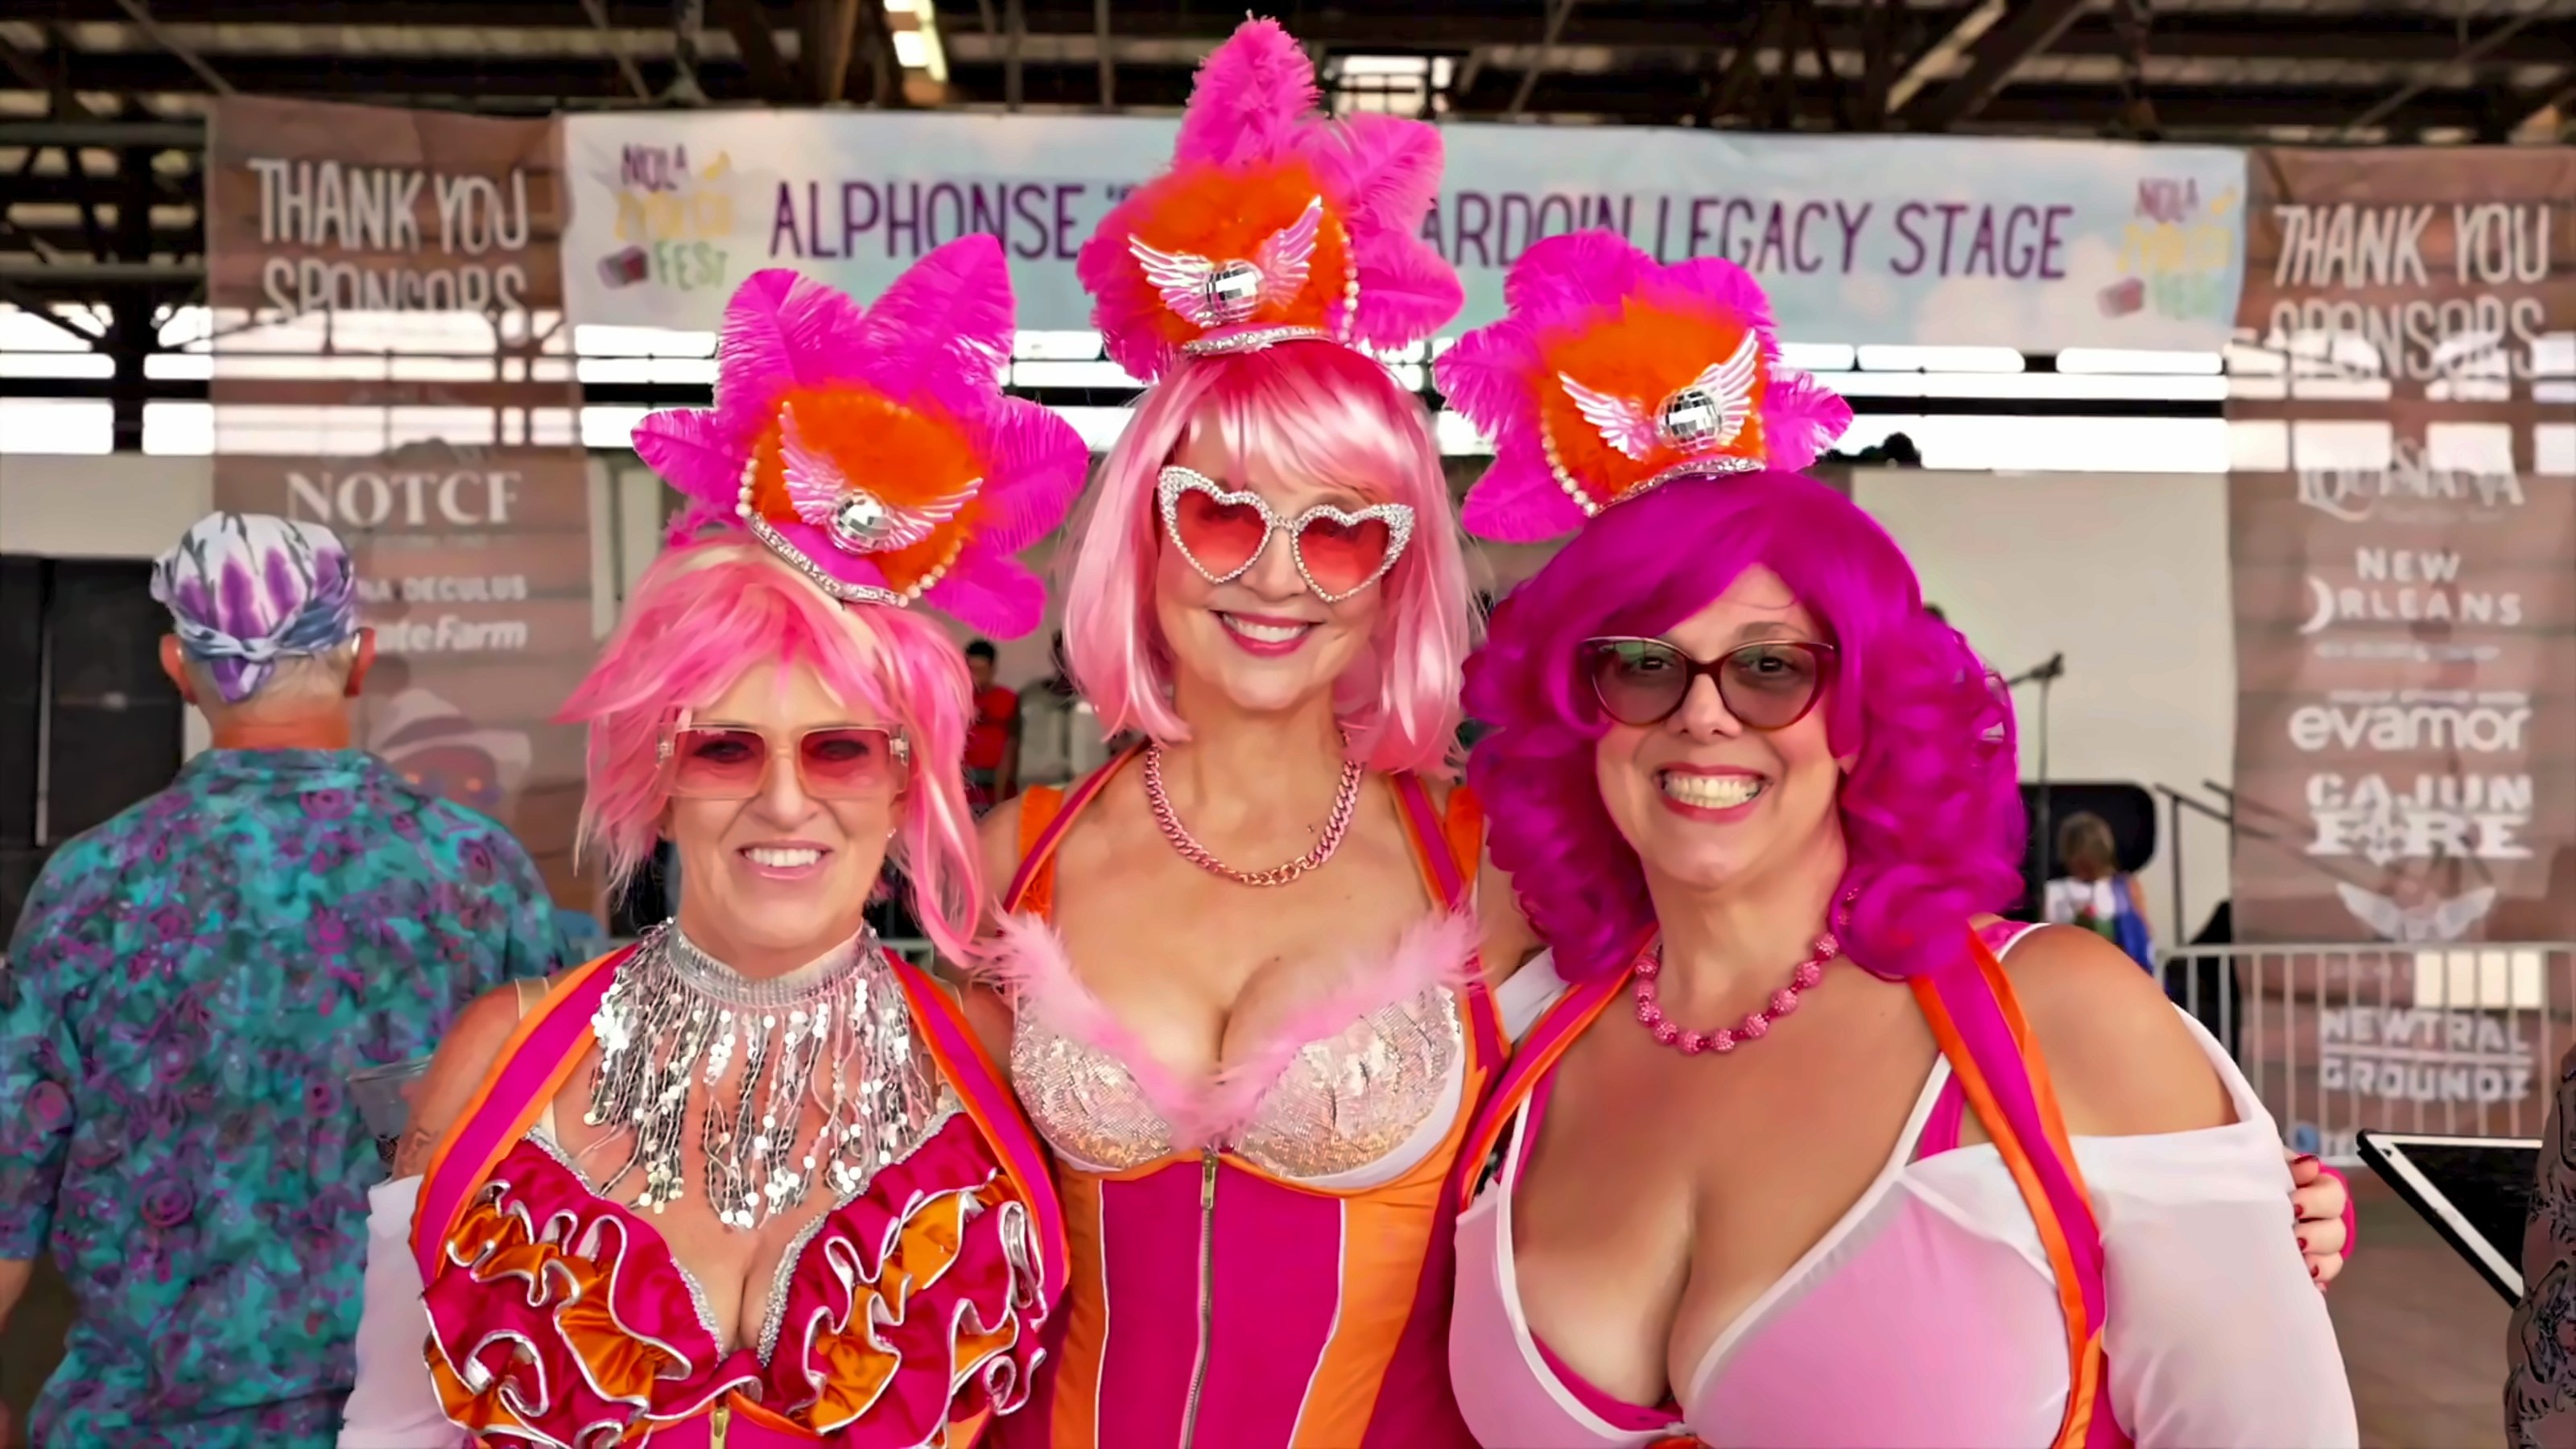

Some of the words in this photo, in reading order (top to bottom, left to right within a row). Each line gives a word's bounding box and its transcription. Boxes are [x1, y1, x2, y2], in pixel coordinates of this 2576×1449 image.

[247, 159, 425, 252] THANK
[433, 167, 529, 255] YOU
[769, 181, 1086, 260] ALPHONSE
[1647, 195, 1872, 275] LEGACY
[1889, 201, 2074, 279] STAGE
[2273, 203, 2435, 289] THANK
[2453, 203, 2551, 285] YOU
[286, 470, 524, 529] NOTCF
[2355, 547, 2461, 582] NEW
[375, 613, 529, 654] ateFarm
[2287, 705, 2533, 753] evamor
[2305, 773, 2533, 812] CAJUN
[2320, 1007, 2532, 1053] NEWTRAL
